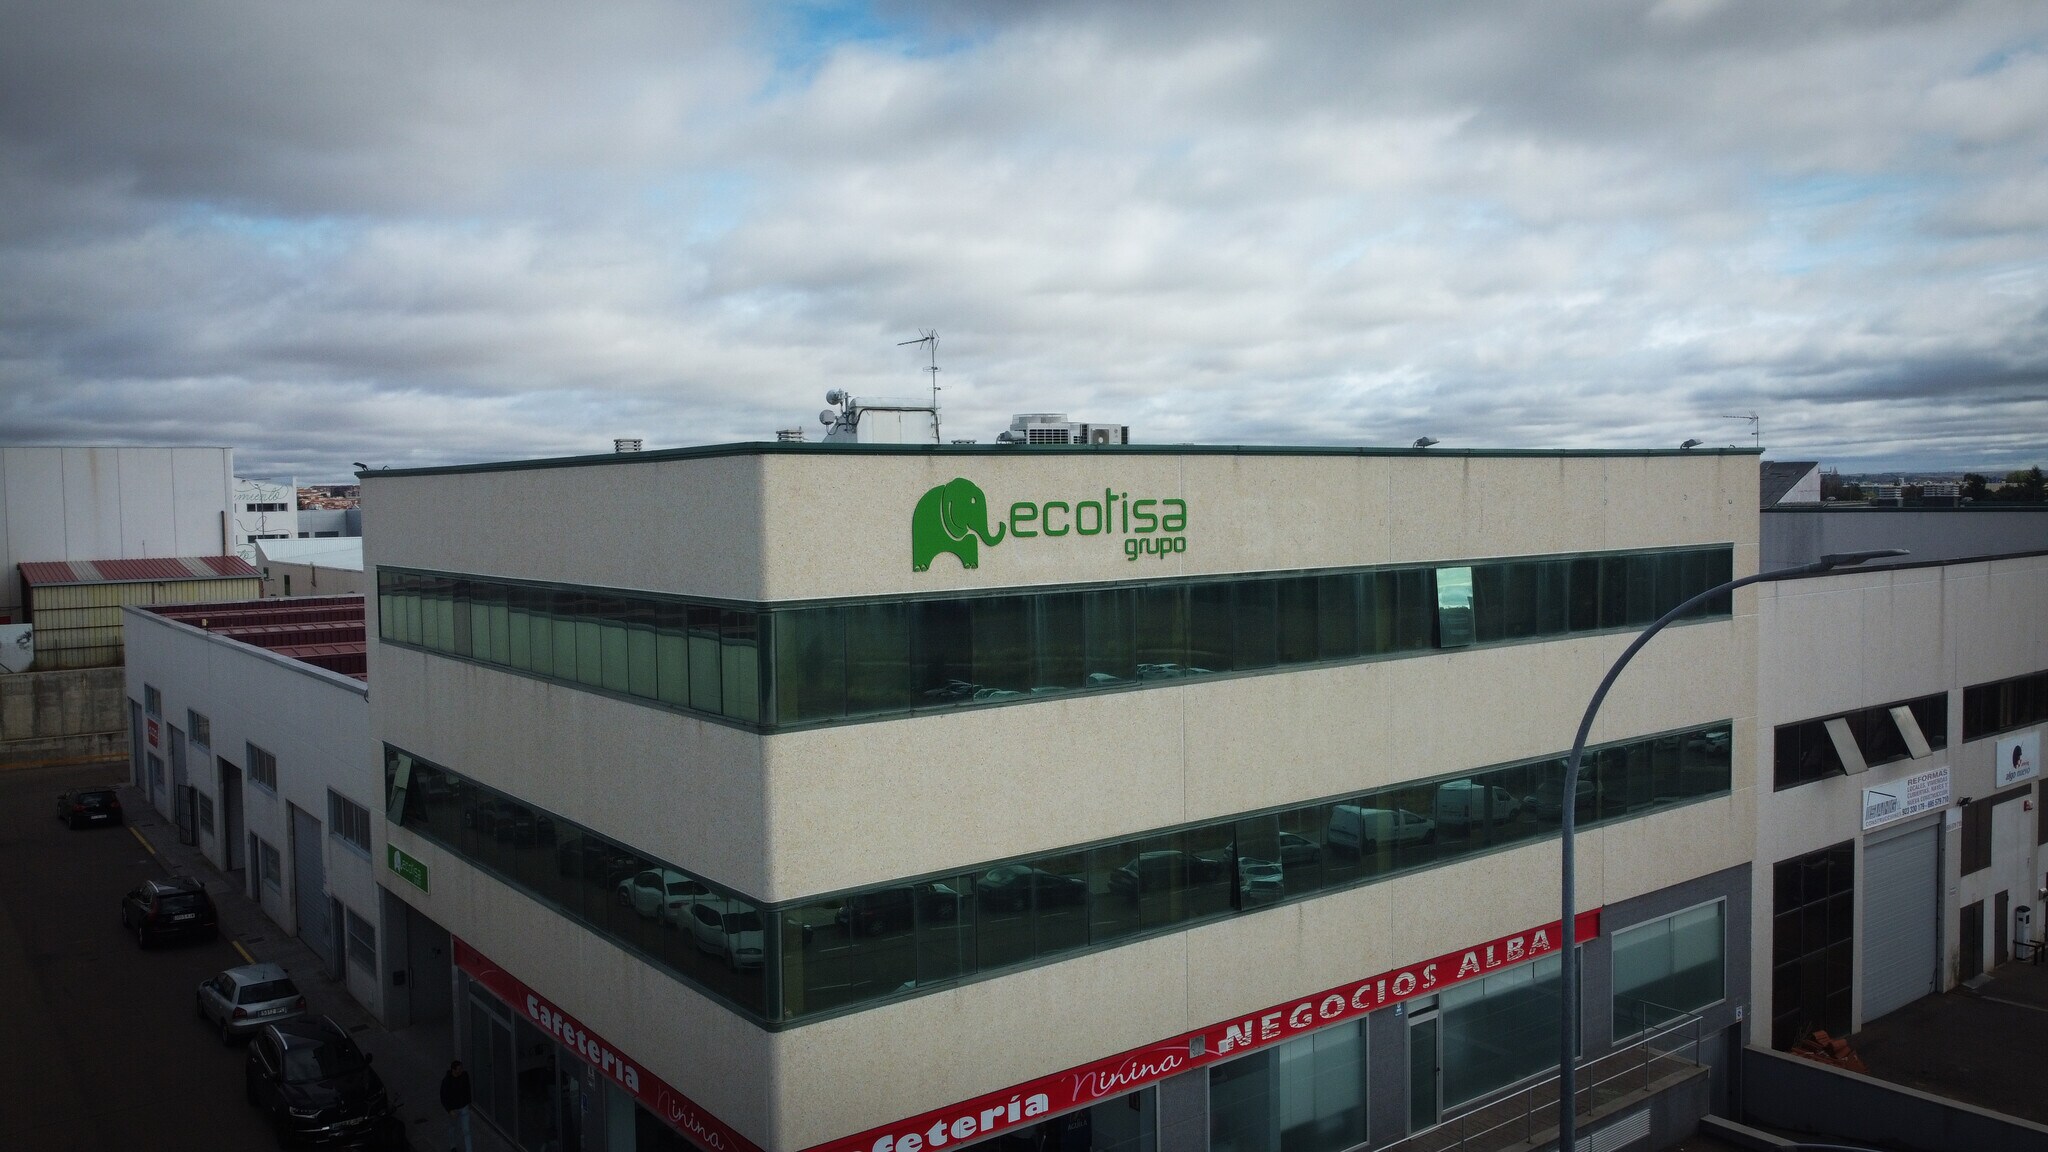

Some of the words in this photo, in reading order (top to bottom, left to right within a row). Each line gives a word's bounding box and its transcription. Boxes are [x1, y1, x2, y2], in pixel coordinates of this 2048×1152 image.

[1010, 487, 1187, 538] ecotisa
[1124, 536, 1187, 561] grupo
[1907, 769, 1948, 786] REFORMAS
[2005, 770, 2016, 782] algo
[2017, 767, 2031, 777] nuevo
[1220, 963, 1438, 1052] NEGOCIOS
[1456, 928, 1551, 978] ALBA
[657, 1083, 725, 1151] Ninina
[853, 1094, 1050, 1152] fetería
[1061, 1052, 1183, 1102] Ninina
